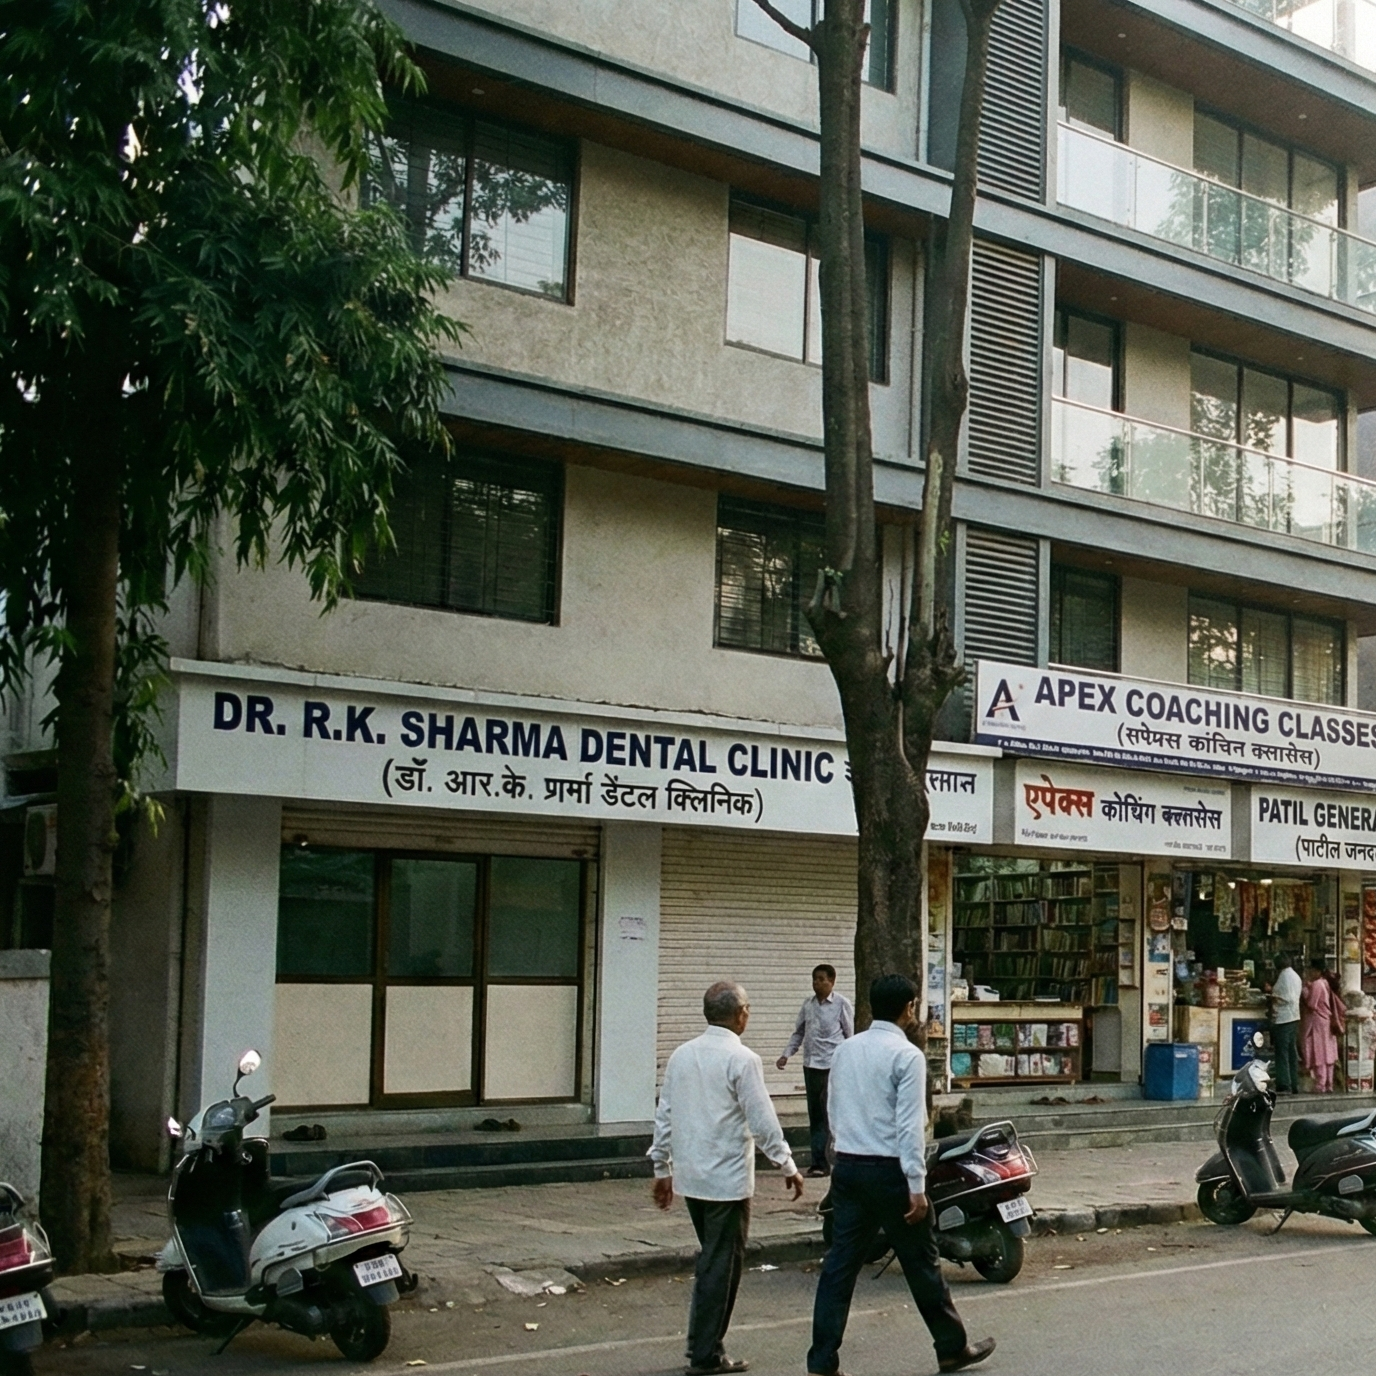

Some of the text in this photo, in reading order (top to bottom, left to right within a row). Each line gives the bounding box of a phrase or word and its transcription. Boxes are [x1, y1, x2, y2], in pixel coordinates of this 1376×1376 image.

[1035, 676, 1117, 714] APEX
[1126, 689, 1270, 734] COACHING
[213, 692, 286, 735] DR.
[303, 701, 386, 744] R.K.
[401, 711, 568, 761] SHARMA
[580, 728, 716, 774] DENTAL
[728, 743, 834, 784] CLINIC
[382, 757, 432, 798] (डॉ.
[600, 773, 659, 809] डेंटल
[665, 778, 763, 823] क्लिनिक)
[1023, 774, 1095, 820] एपेक्स
[1259, 797, 1308, 826] PATIL
[1296, 833, 1341, 862] (पाटील
